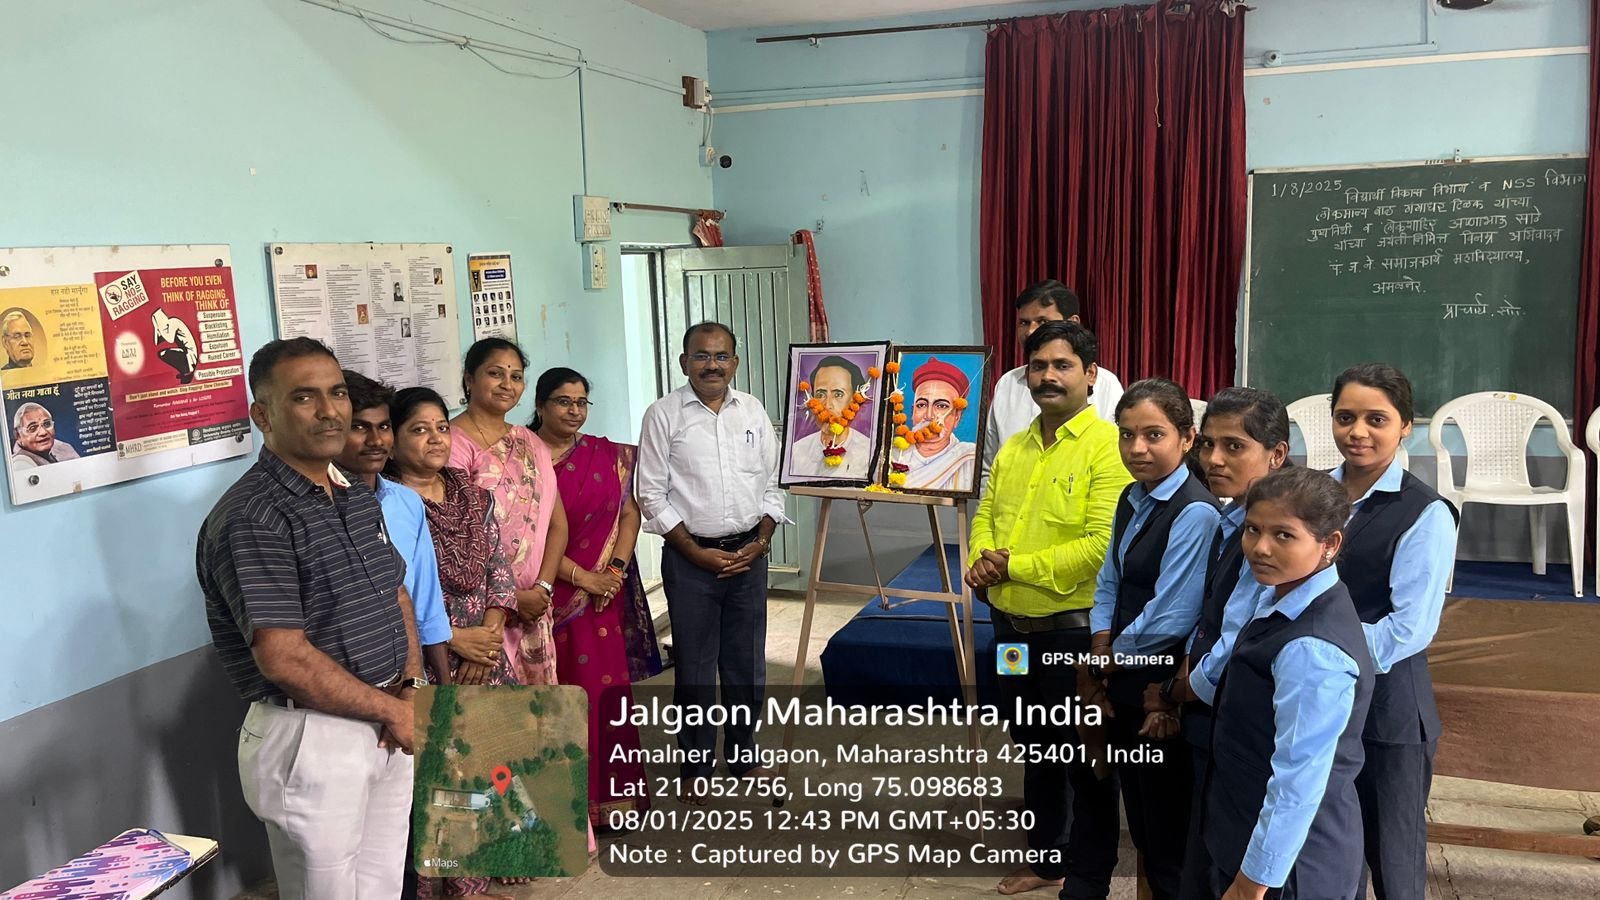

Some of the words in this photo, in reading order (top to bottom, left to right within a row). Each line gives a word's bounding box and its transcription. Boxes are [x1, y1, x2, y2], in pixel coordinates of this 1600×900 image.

[1271, 179, 1343, 199] 1/8/2025
[1502, 177, 1536, 191] NSS
[120, 274, 138, 290] SAY
[160, 276, 189, 288] BEFORE
[190, 275, 204, 287] YOU
[204, 274, 223, 286] EVEN
[125, 287, 137, 299] NO
[161, 292, 184, 303] THINK
[185, 291, 195, 302] OF
[195, 289, 226, 300] RAGGING
[112, 292, 147, 317] RAGGING
[195, 299, 218, 311] THINK
[219, 298, 230, 309] OF
[203, 311, 227, 319] Suspension
[204, 321, 228, 330] Blacklisting
[206, 331, 230, 339] Humiliation
[208, 341, 229, 350] Expulsion
[207, 353, 223, 361] Ruined
[222, 351, 236, 360] Career
[198, 370, 216, 378] Possible
[7, 389, 21, 401] गीत
[22, 388, 36, 399] नया
[36, 386, 52, 397] गाता
